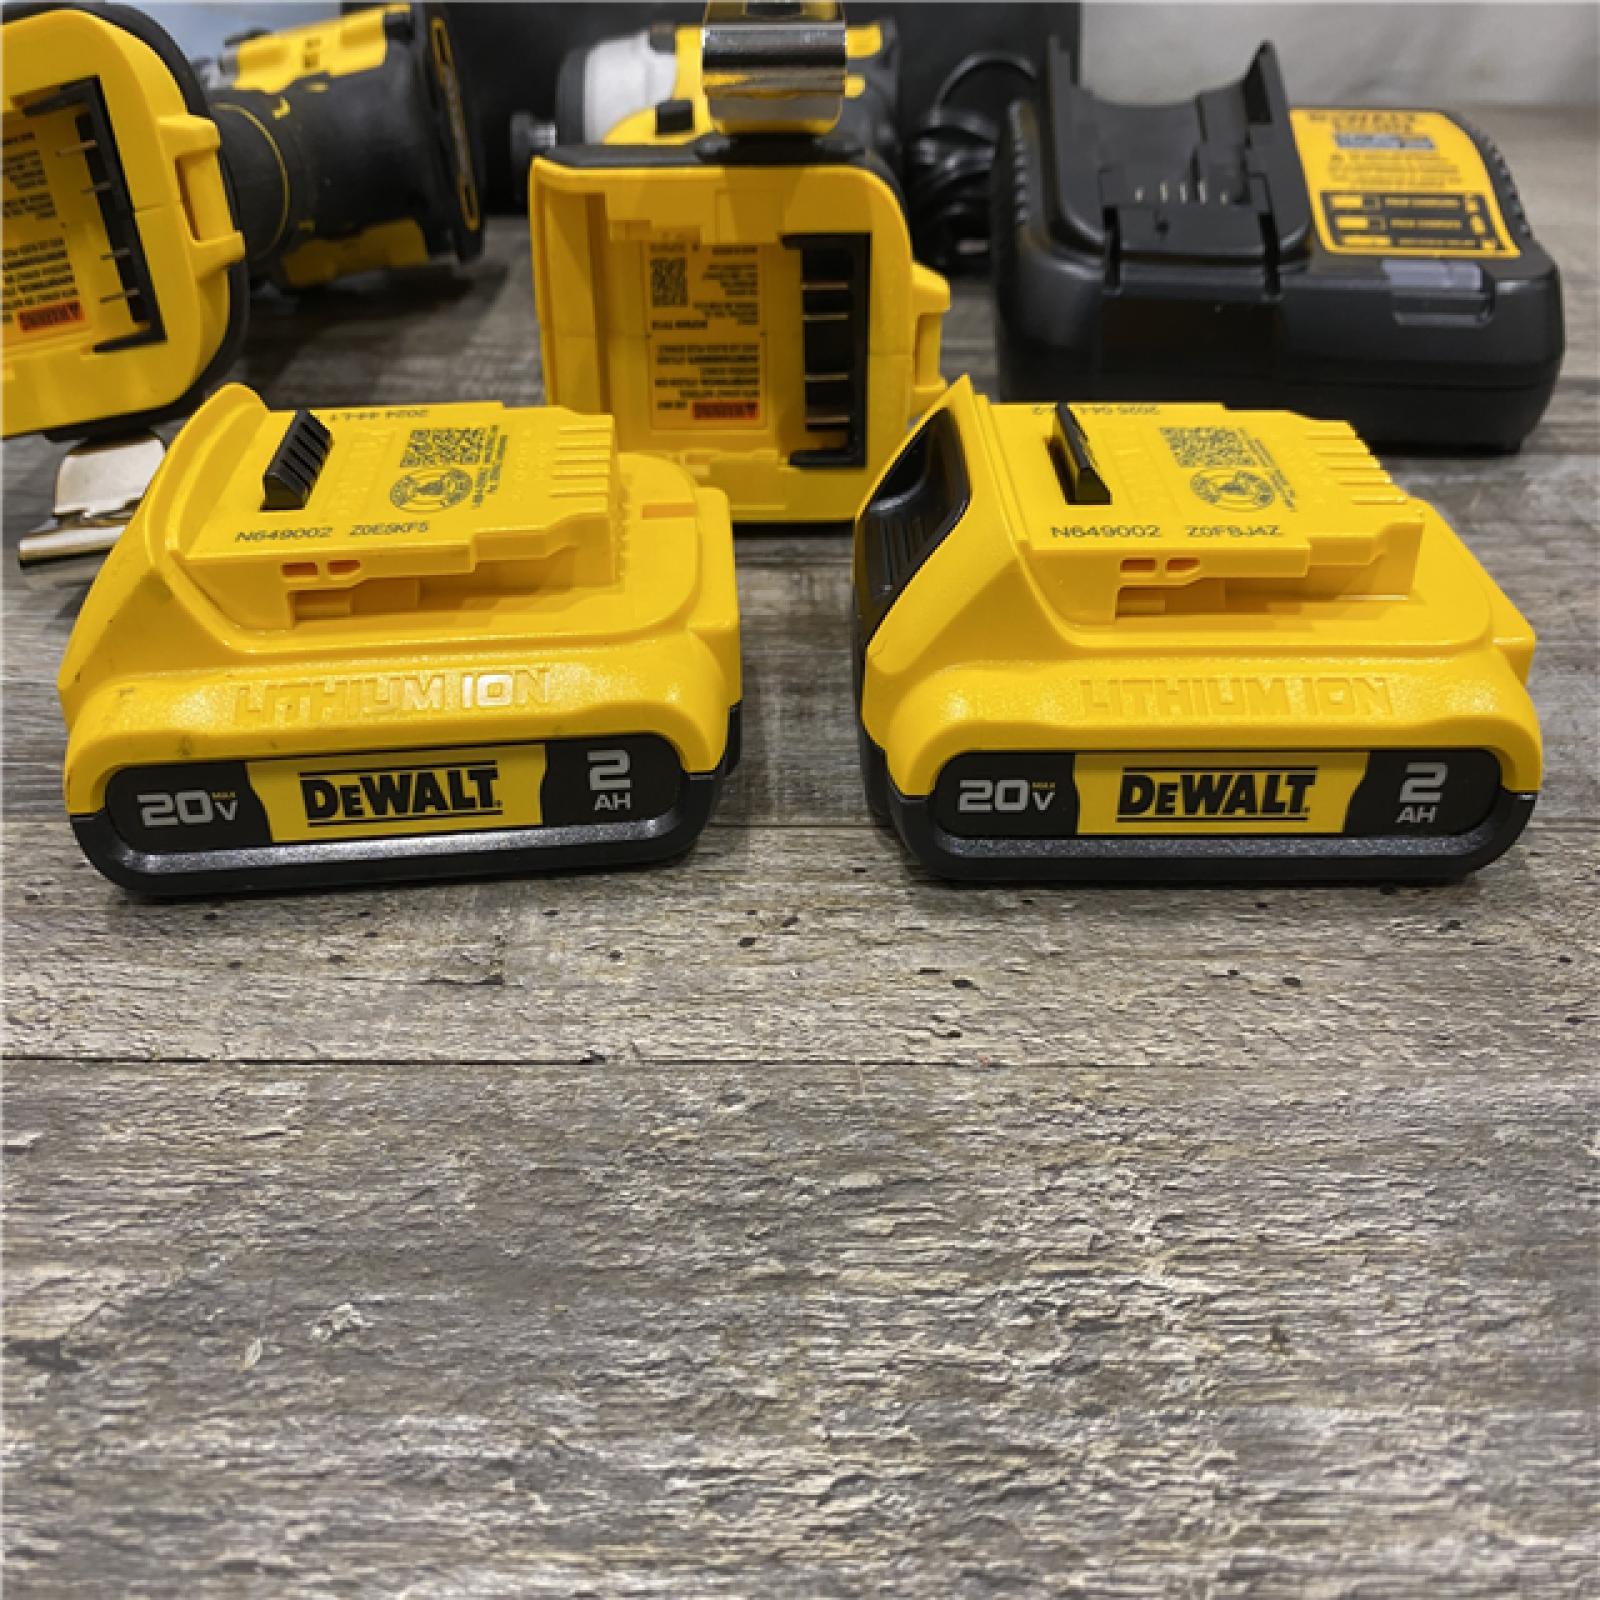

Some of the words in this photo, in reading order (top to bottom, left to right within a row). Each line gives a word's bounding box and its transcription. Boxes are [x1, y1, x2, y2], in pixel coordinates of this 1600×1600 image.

[236, 526, 333, 541] N649002
[1050, 524, 1162, 538] N649002
[235, 674, 445, 724] LITHIUM
[461, 668, 550, 709] ION
[1079, 677, 1290, 721] LITHIUM
[1302, 677, 1393, 717] ION
[586, 750, 631, 791] 2
[1399, 762, 1448, 803] 2
[594, 792, 631, 812] AH
[1395, 805, 1437, 823] AH
